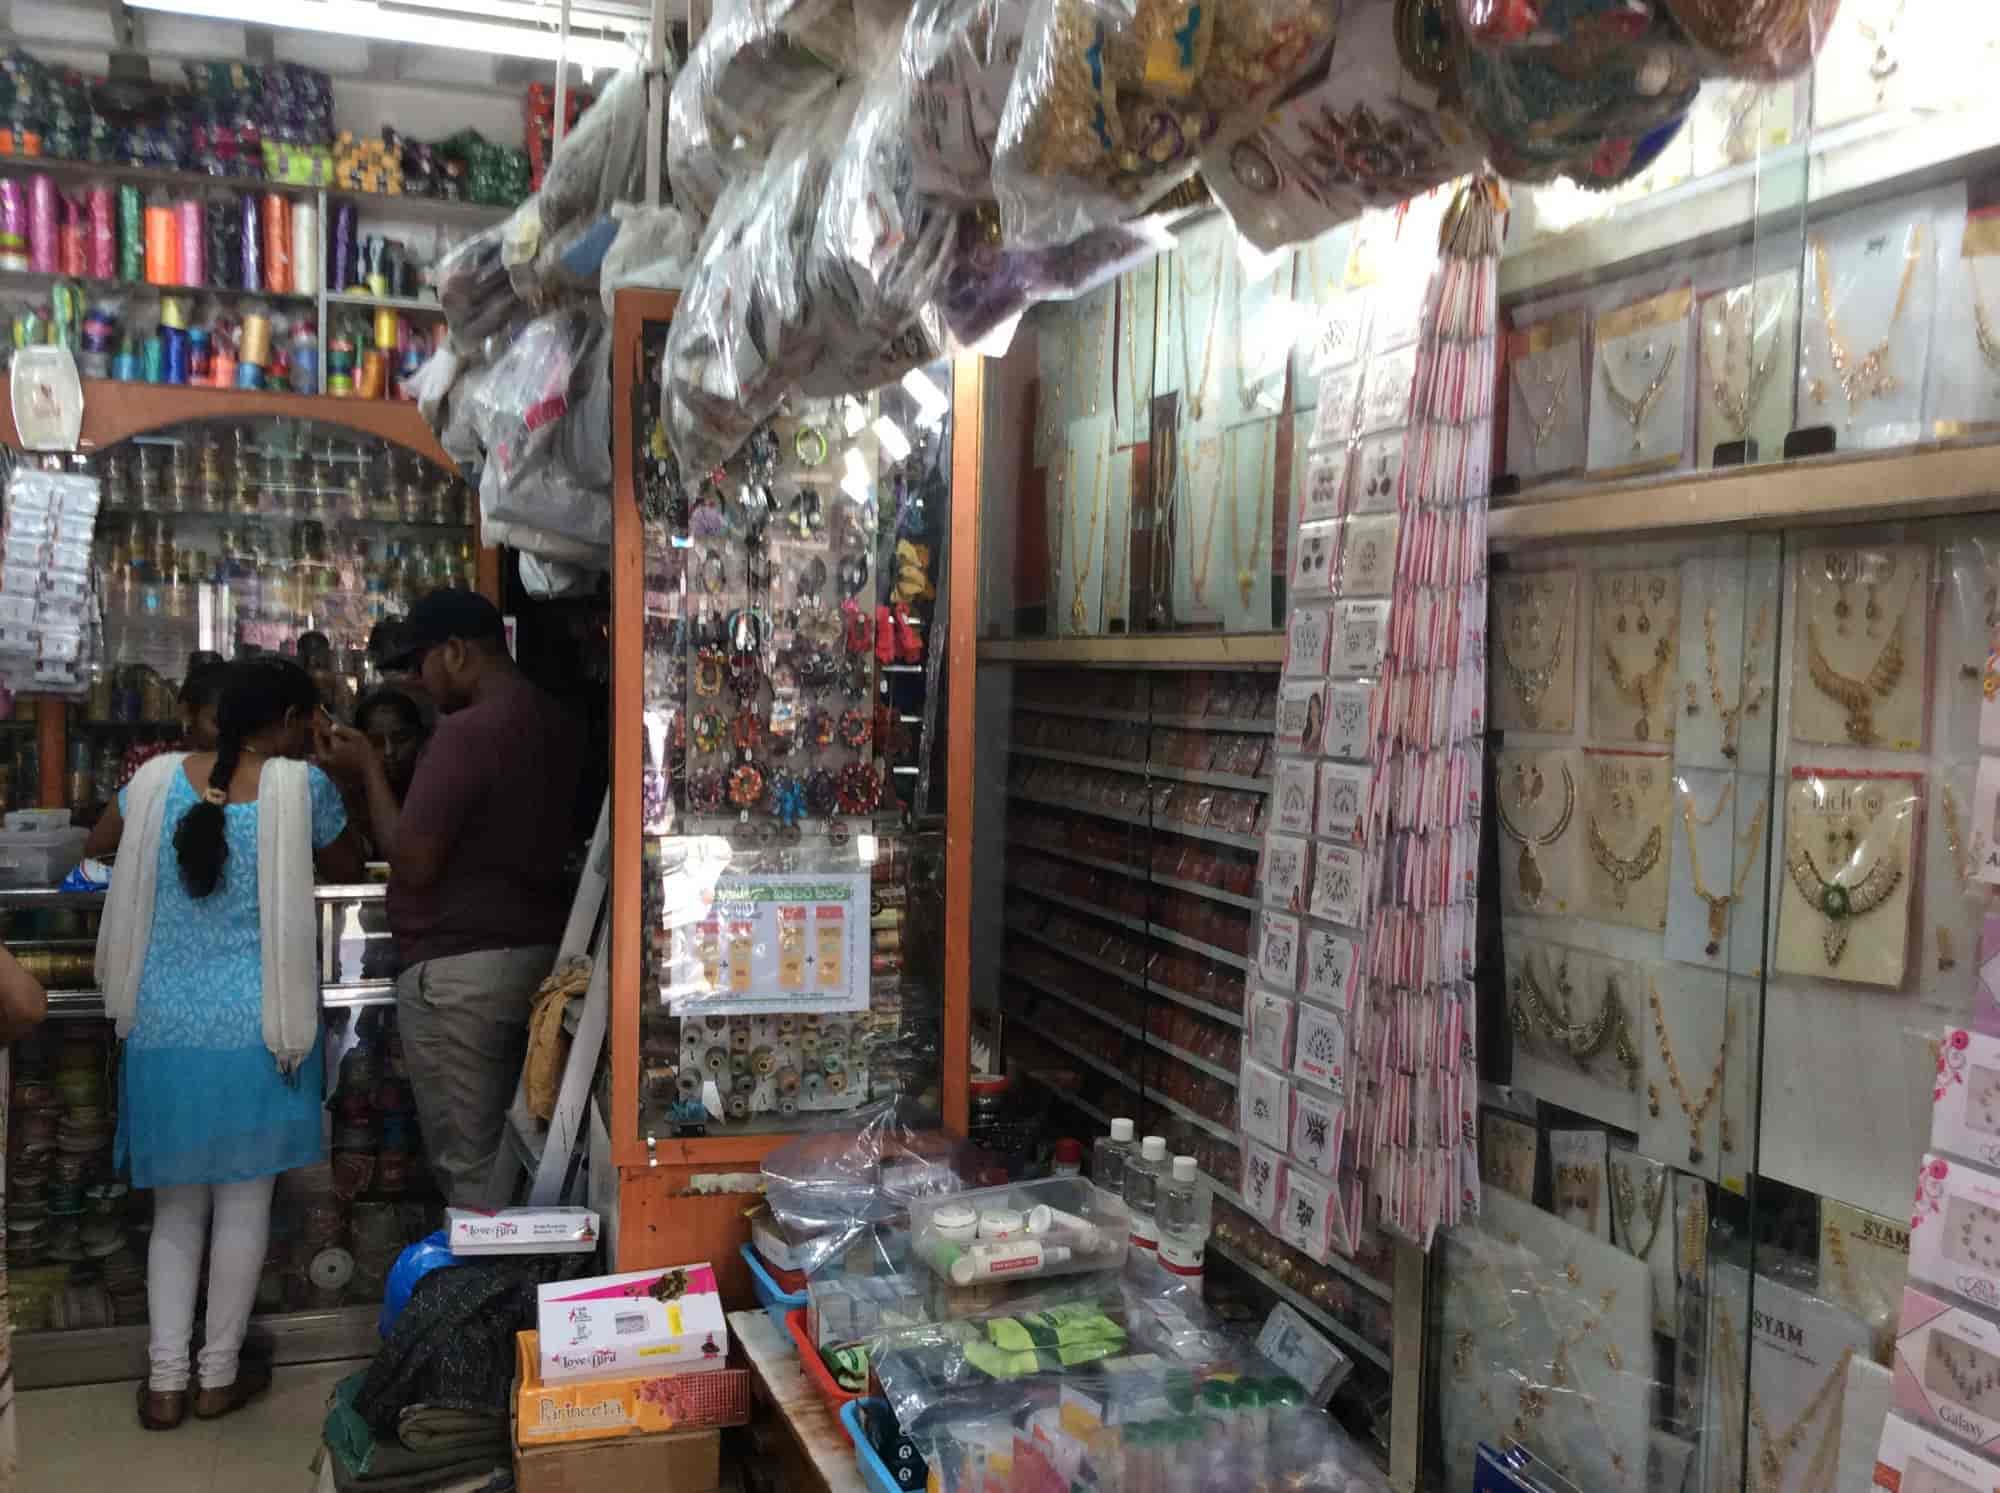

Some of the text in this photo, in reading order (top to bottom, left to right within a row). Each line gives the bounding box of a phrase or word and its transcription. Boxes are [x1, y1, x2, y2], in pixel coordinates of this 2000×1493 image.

[1863, 1219, 1909, 1248] SYAM
[1753, 1310, 1804, 1346] SYAM
[1939, 1405, 1984, 1438] Galaxy
